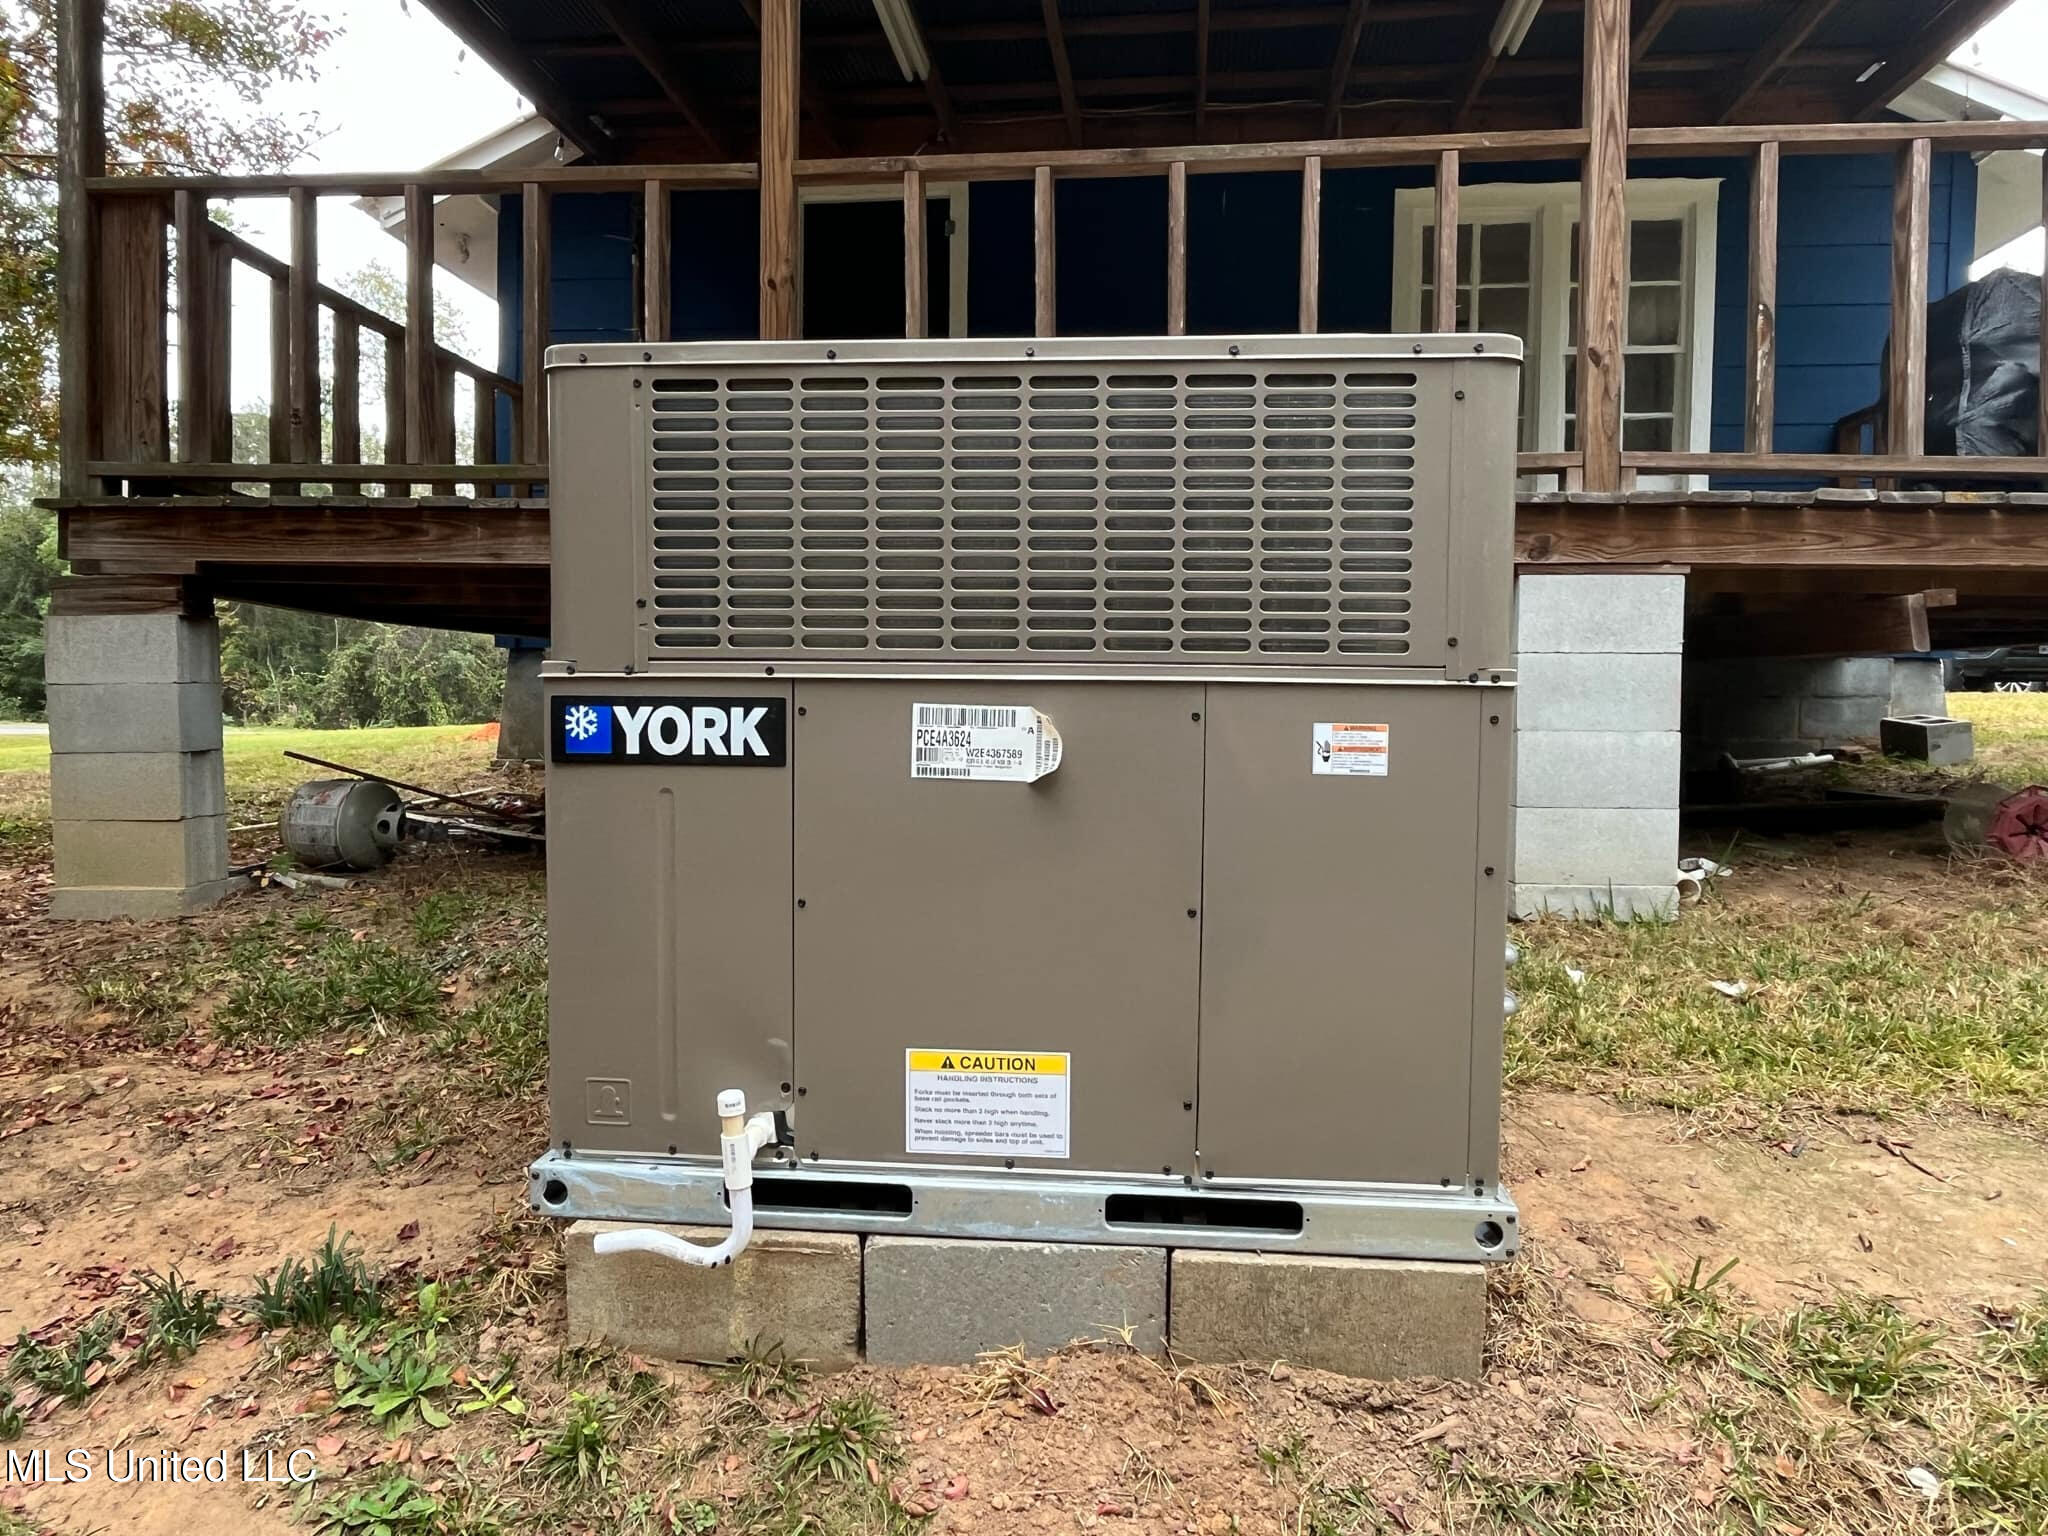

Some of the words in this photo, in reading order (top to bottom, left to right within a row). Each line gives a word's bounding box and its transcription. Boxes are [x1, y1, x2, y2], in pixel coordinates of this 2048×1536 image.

[612, 705, 770, 756] YORK
[916, 729, 972, 747] PCE4A3624
[960, 1056, 1036, 1071] CAUTION
[937, 1074, 978, 1082] HANDLING
[980, 1075, 1039, 1084] INSTRUCTIONS
[990, 1091, 1016, 1099] through
[984, 1108, 999, 1116] high
[940, 1136, 966, 1144] damage
